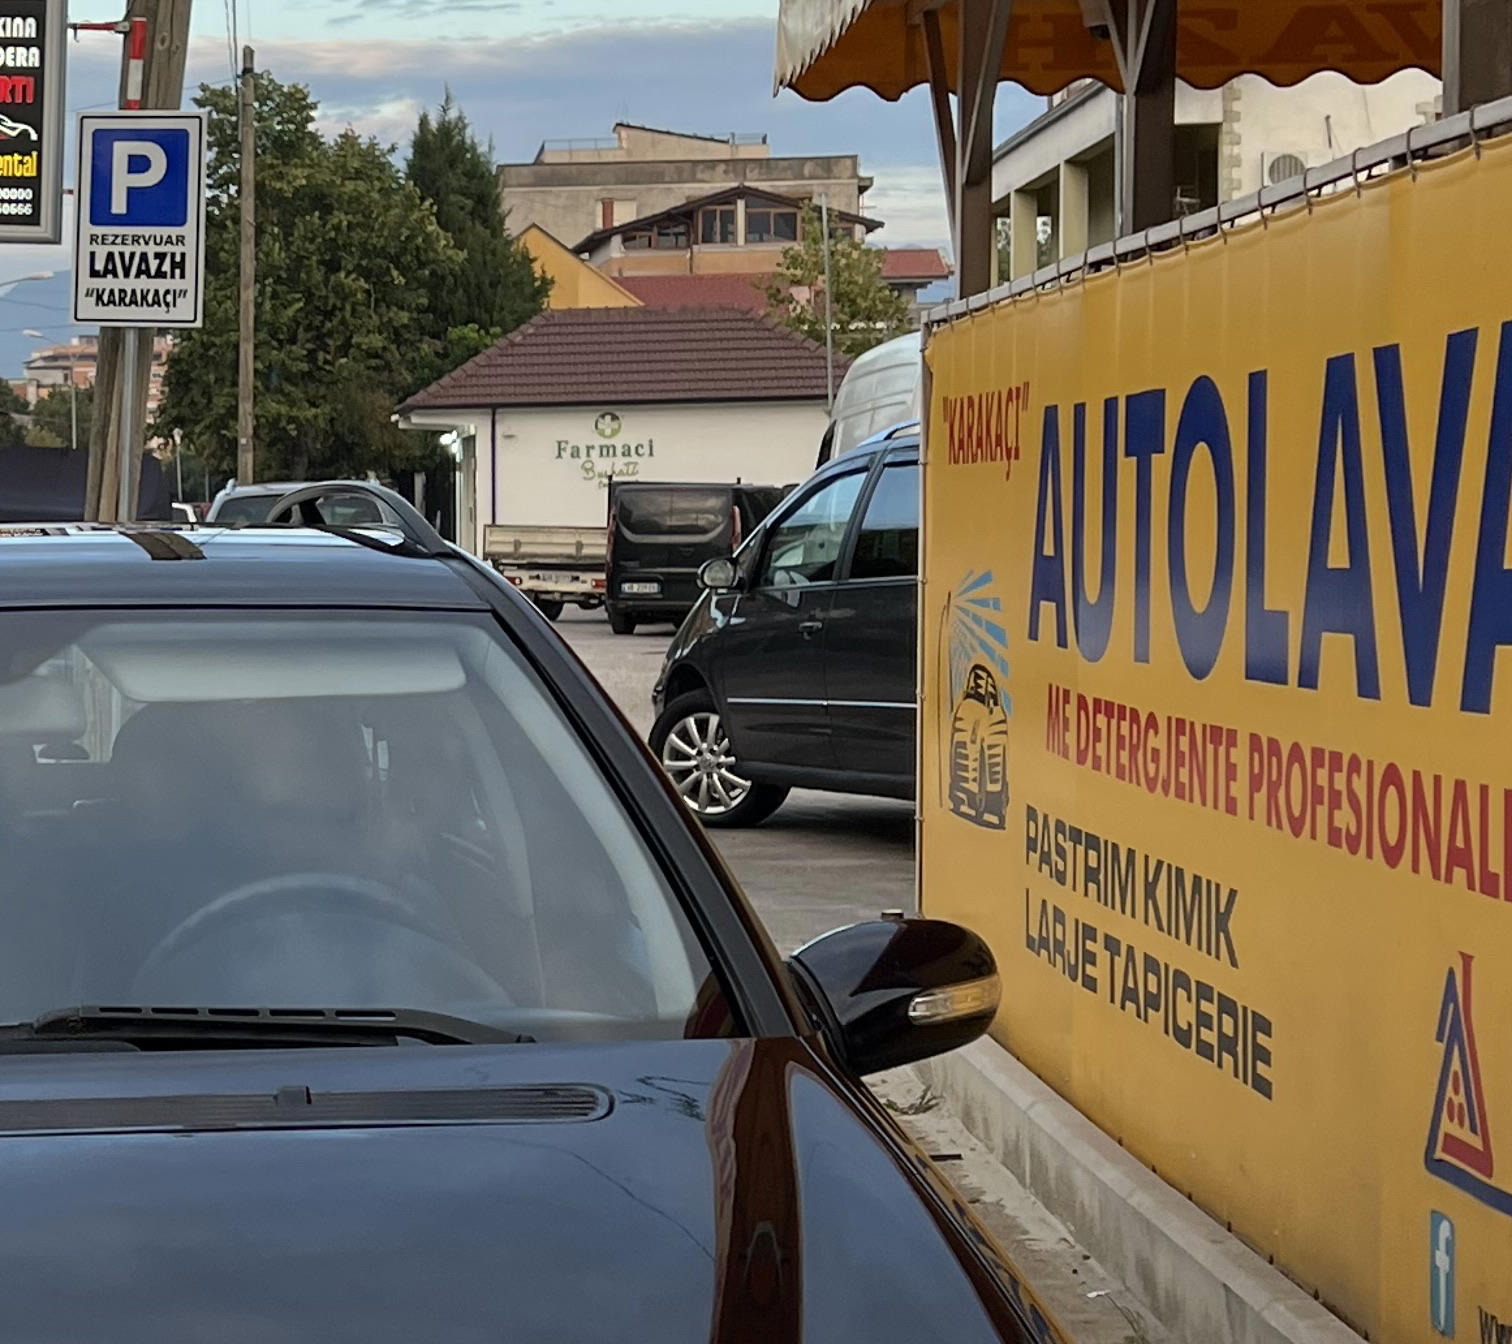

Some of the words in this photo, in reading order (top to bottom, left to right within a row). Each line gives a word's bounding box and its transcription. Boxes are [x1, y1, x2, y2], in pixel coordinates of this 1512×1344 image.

[110, 140, 167, 215] P
[89, 233, 186, 246] REZERVUAR
[89, 251, 186, 279] LAVAZH
[555, 438, 655, 459] Farmaci
[1046, 683, 1070, 760] ME
[1075, 692, 1238, 817] DETERGJENTE
[1025, 803, 1136, 920] PASTRIM
[1143, 853, 1239, 970] KIMIK
[1025, 887, 1098, 995] LARJE
[1103, 932, 1273, 1101] TAPICERIE
